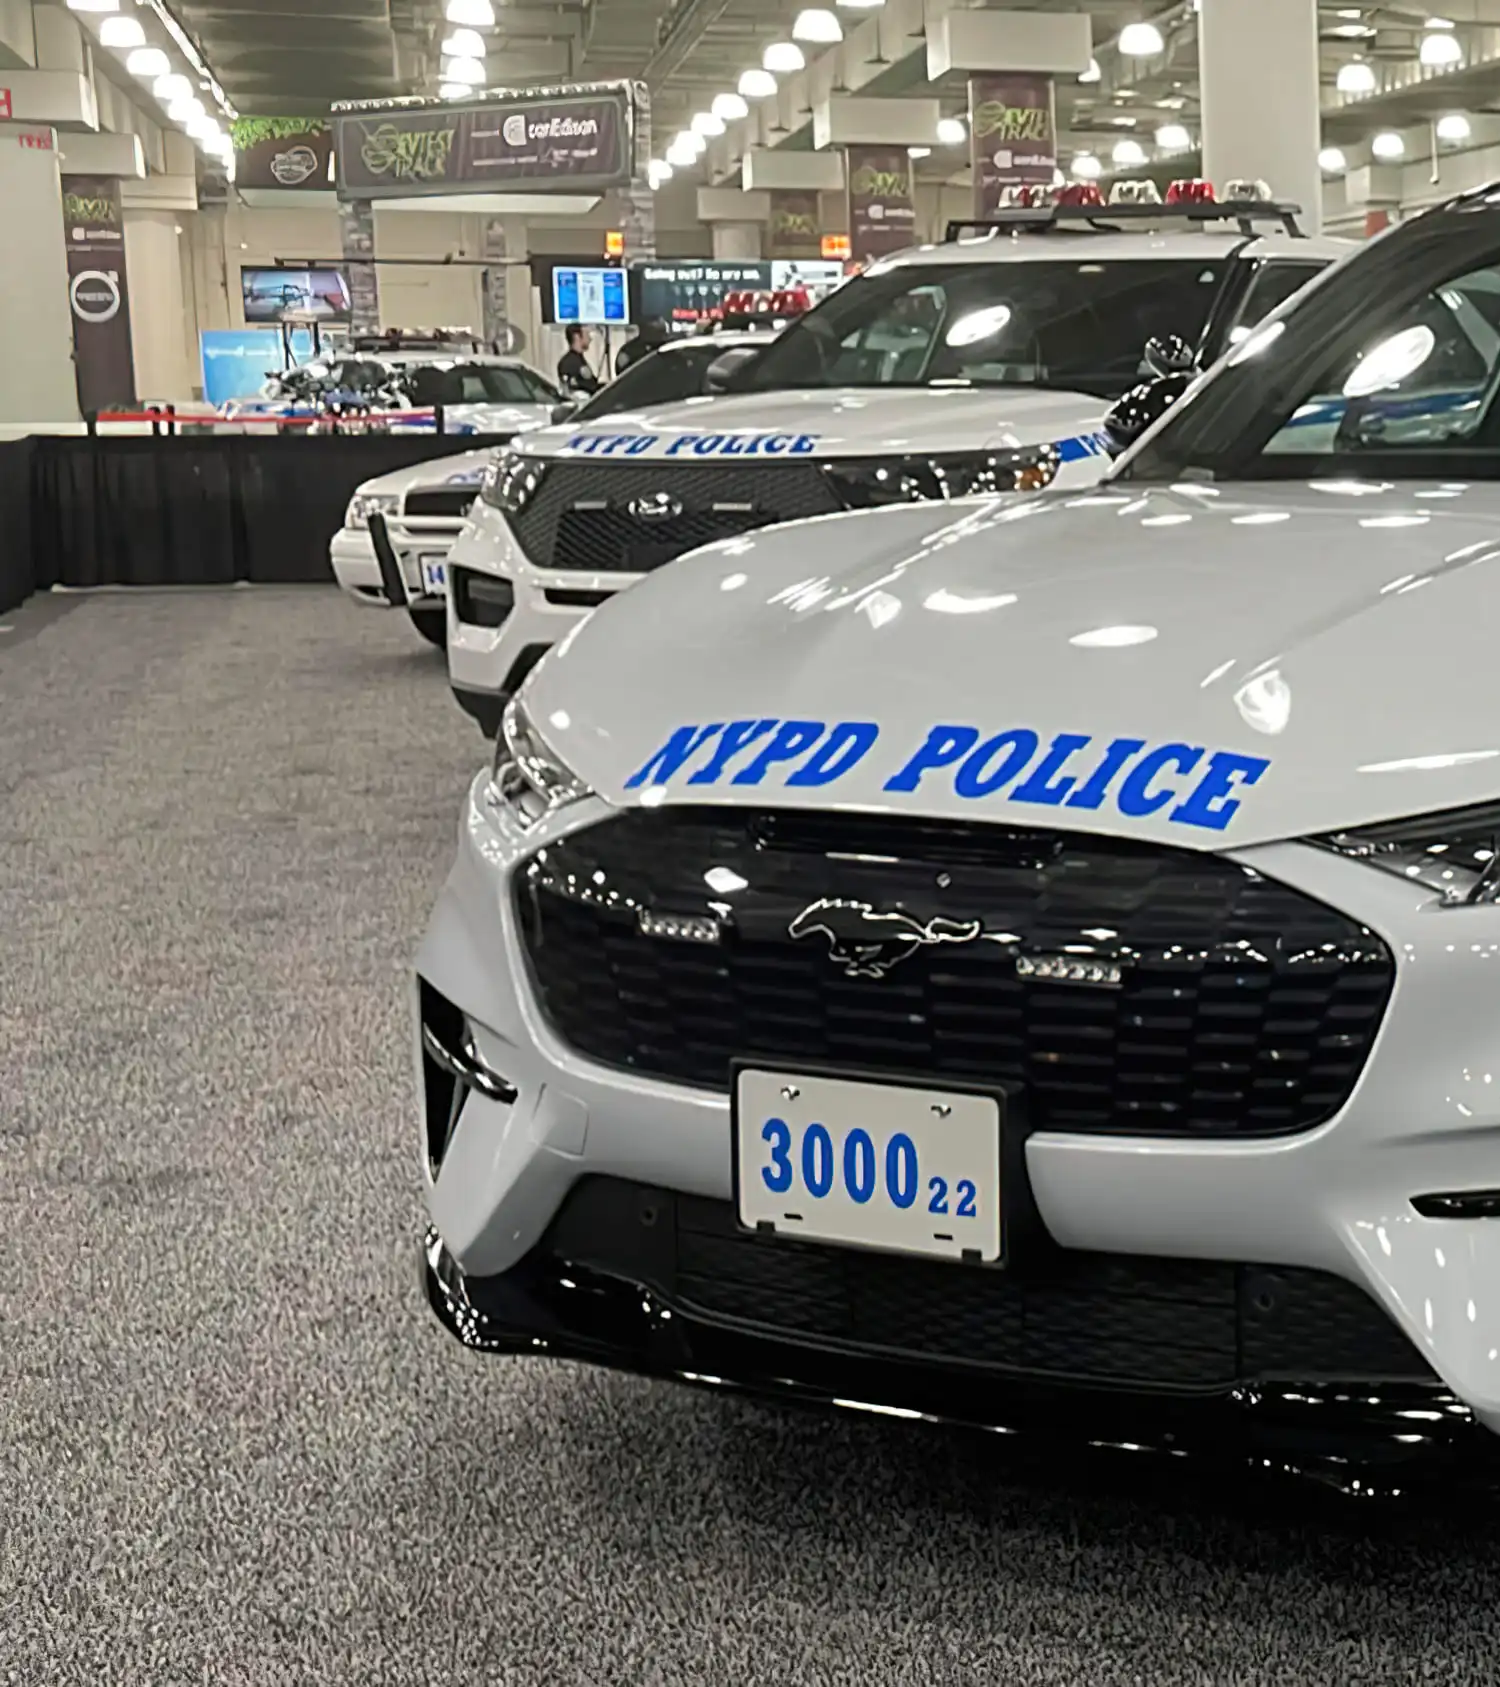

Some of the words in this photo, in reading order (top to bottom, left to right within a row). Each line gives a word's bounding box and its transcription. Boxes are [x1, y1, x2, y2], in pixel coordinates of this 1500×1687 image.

[567, 434, 659, 454] NYPD
[664, 433, 822, 455] POLICE
[623, 719, 879, 790] NYPD
[882, 724, 1271, 832] POLICE
[761, 1118, 918, 1209] 3000
[928, 1176, 976, 1217] 22
